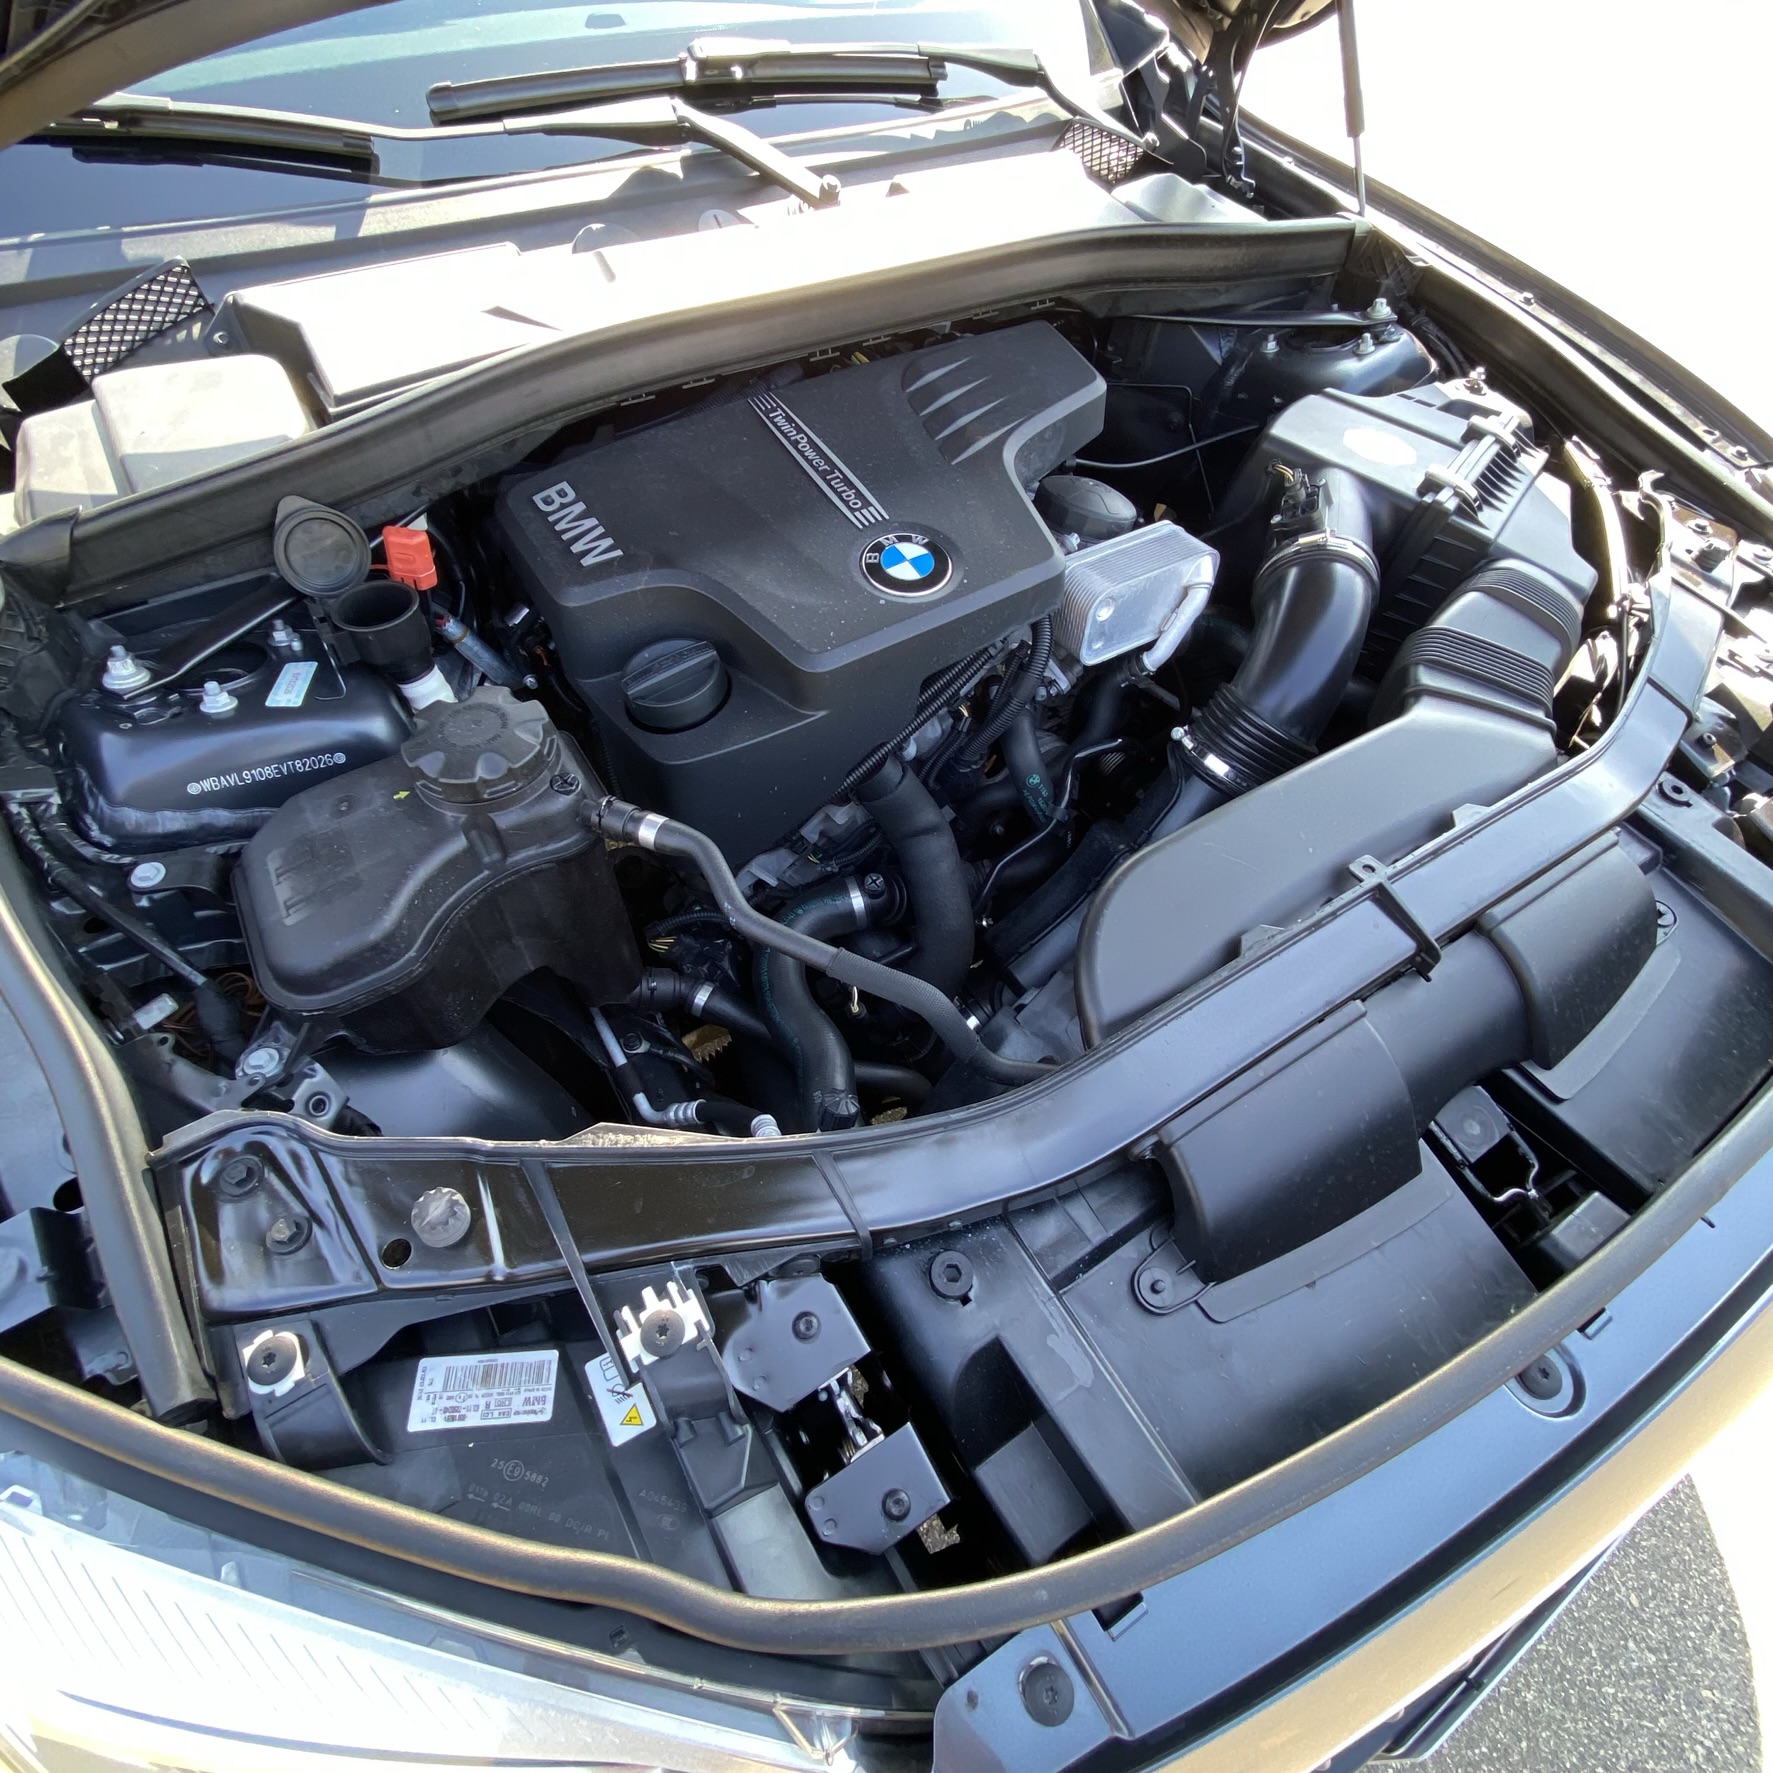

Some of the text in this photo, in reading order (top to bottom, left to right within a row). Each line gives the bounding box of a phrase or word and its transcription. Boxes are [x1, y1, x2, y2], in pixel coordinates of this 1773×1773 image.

[768, 407, 863, 510] TwinPower Turbo
[532, 480, 624, 567] BMW
[490, 1458, 505, 1470] 25
[524, 1470, 550, 1488] 5882
